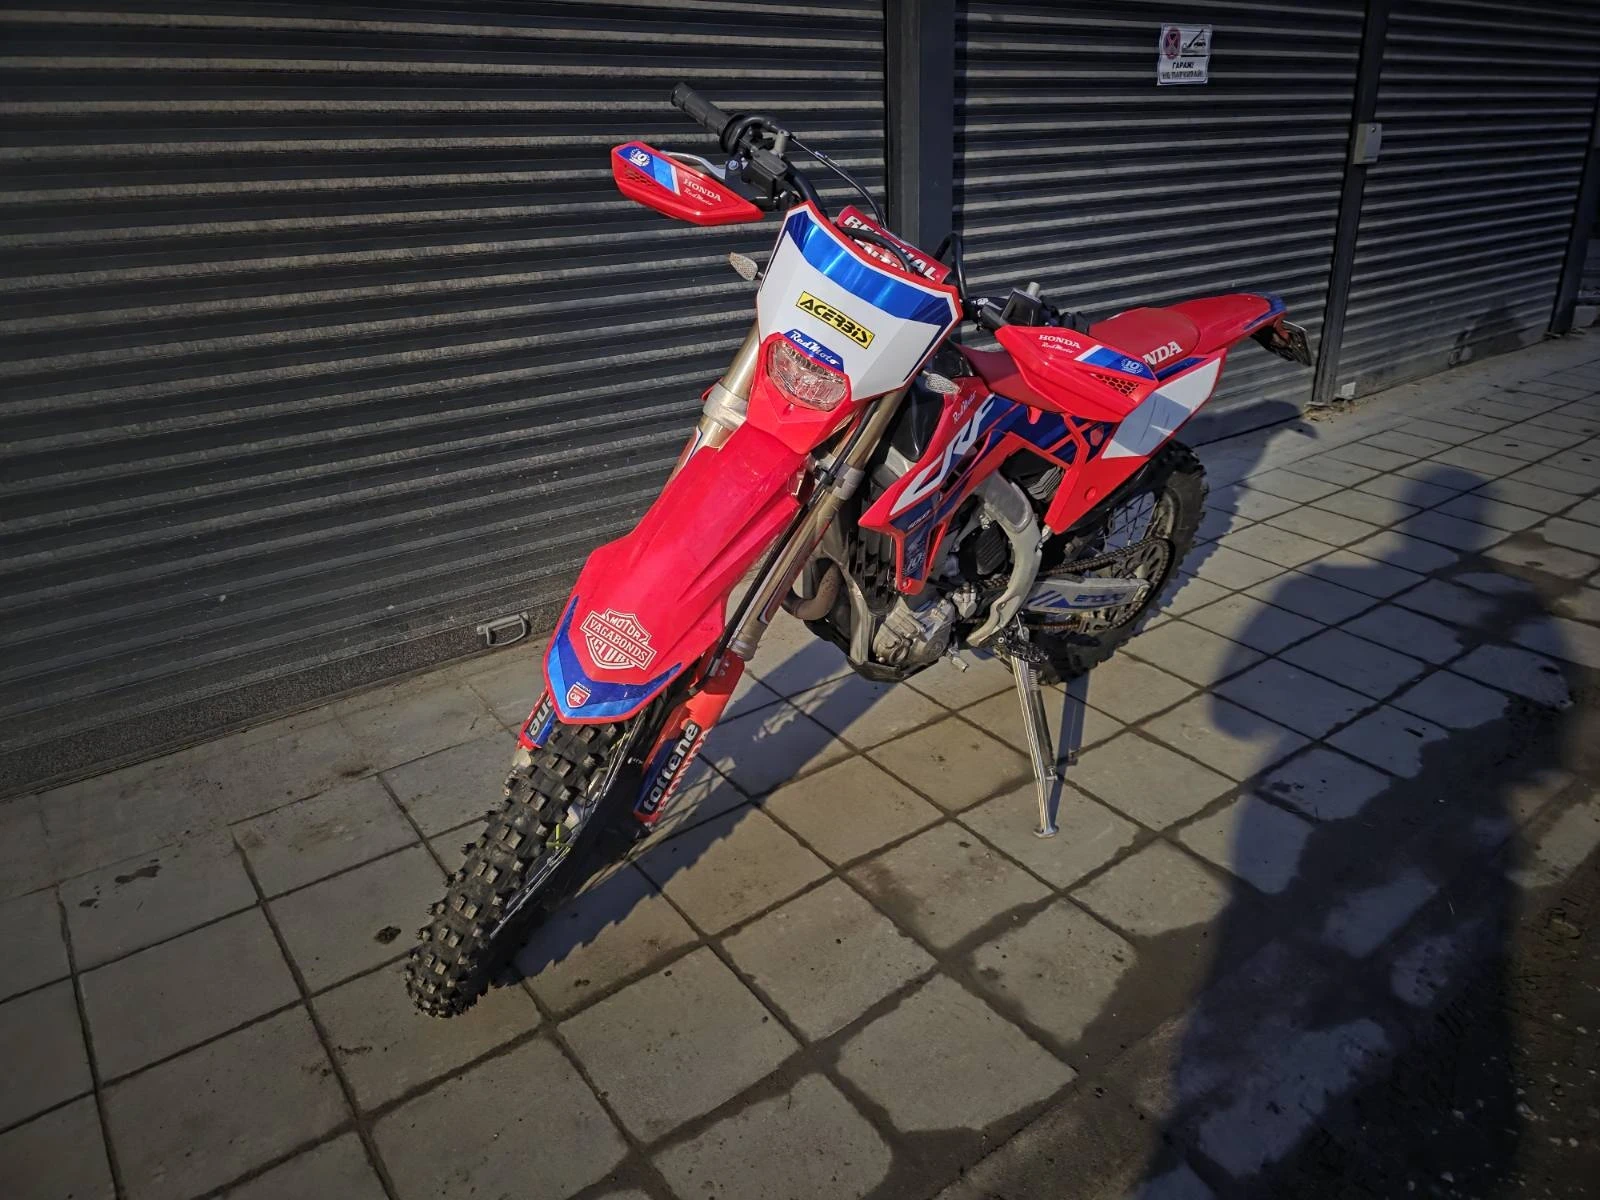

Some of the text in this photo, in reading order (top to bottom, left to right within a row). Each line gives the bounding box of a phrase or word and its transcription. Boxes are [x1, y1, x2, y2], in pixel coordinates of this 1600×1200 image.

[683, 178, 722, 202] HONDA
[800, 298, 869, 344] ACERBIS
[790, 330, 840, 366] RedMoto
[1038, 334, 1081, 349] HONDA
[1142, 341, 1182, 365] NDA
[590, 619, 648, 661] VAGABONDS
[609, 616, 641, 640] MOTOR
[593, 638, 627, 663] CLUB
